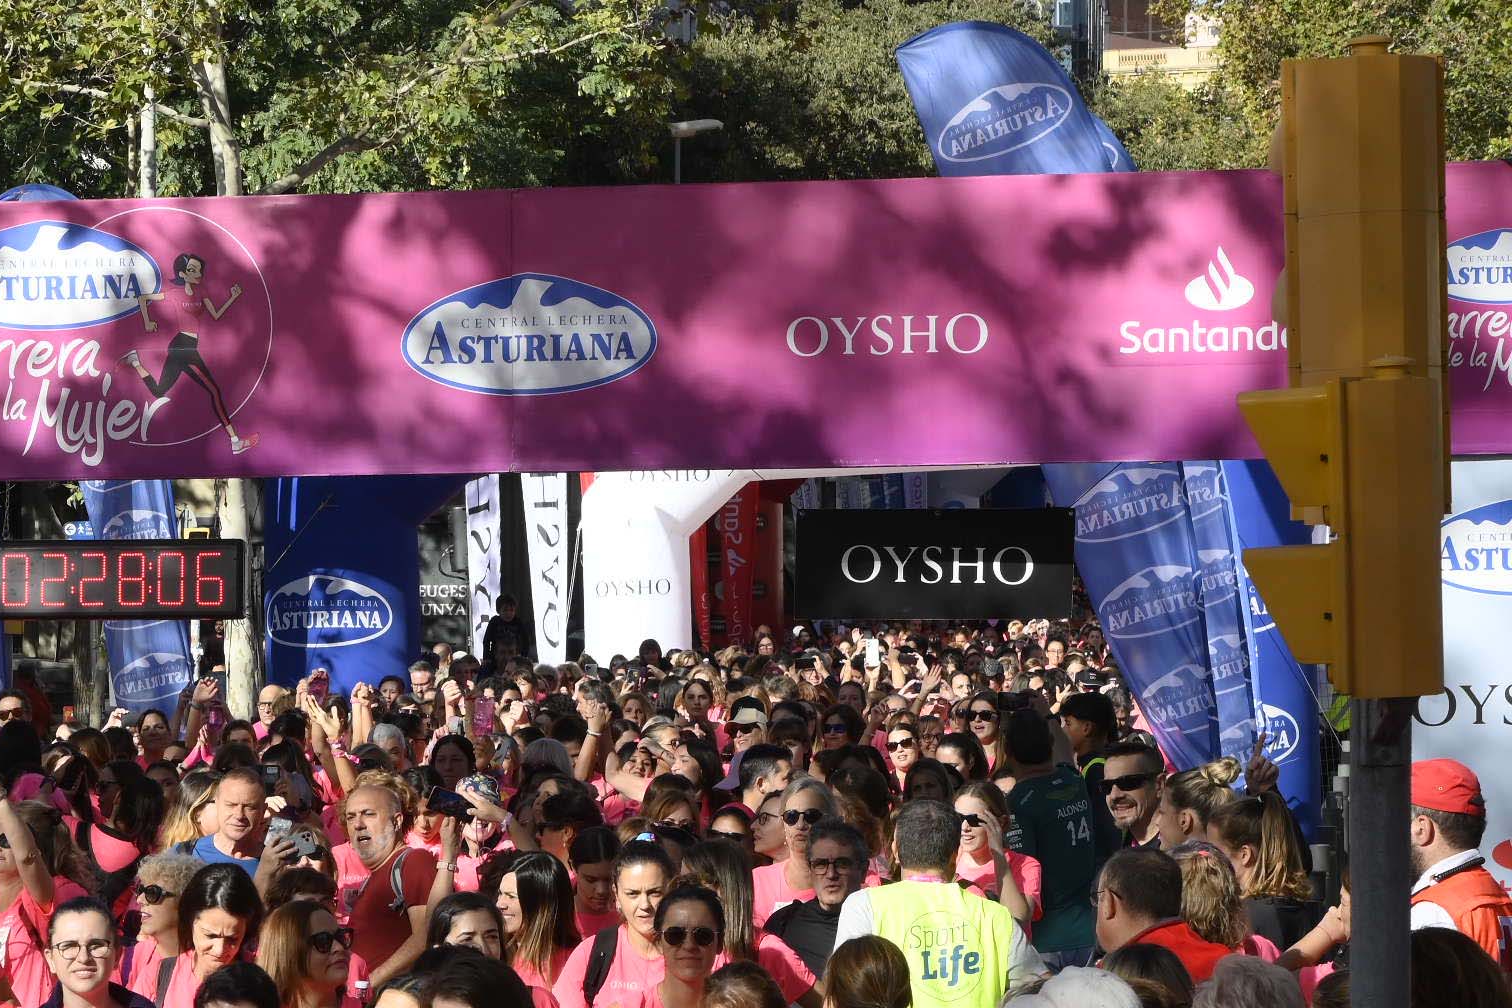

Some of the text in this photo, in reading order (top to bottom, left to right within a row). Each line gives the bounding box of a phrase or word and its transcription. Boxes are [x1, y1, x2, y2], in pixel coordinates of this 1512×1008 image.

[64, 256, 136, 269] LECHERA
[461, 313, 629, 329] CENTRAL LECHERA
[786, 313, 989, 357] OYSHO
[1447, 310, 1512, 340] arre
[422, 320, 637, 365] ASTURIANA
[2, 380, 27, 421] la
[23, 372, 170, 466] Mujer
[841, 544, 1035, 586] OYSHO
[1, 552, 224, 607] 02:28:06
[595, 577, 672, 599] OYSHO
[271, 604, 383, 631] ASTURIANA
[330, 599, 379, 608] LECHERA
[421, 603, 467, 616] UNYA
[1057, 799, 1088, 819] ALONSO
[1067, 816, 1090, 846] 14
[909, 924, 969, 950] Sport
[922, 945, 980, 986] Life
